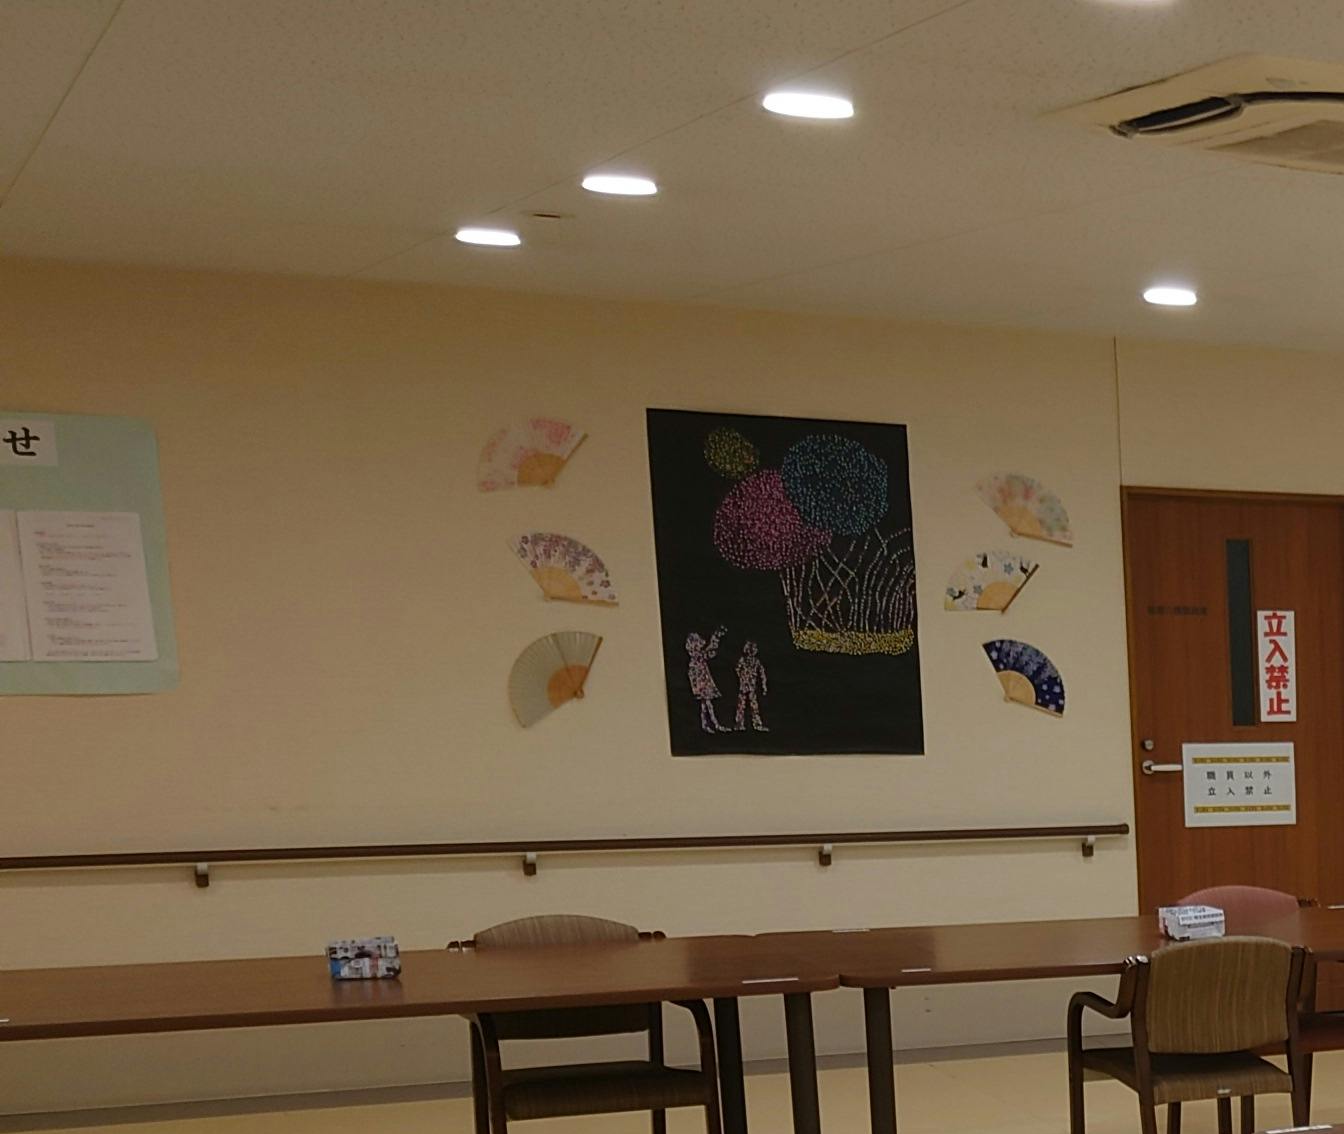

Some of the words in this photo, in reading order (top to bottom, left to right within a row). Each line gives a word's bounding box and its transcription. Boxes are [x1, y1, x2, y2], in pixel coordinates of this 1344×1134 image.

[3, 427, 40, 457] せ
[1264, 612, 1291, 716] 立入禁止
[1208, 787, 1272, 796] 立入禁止
